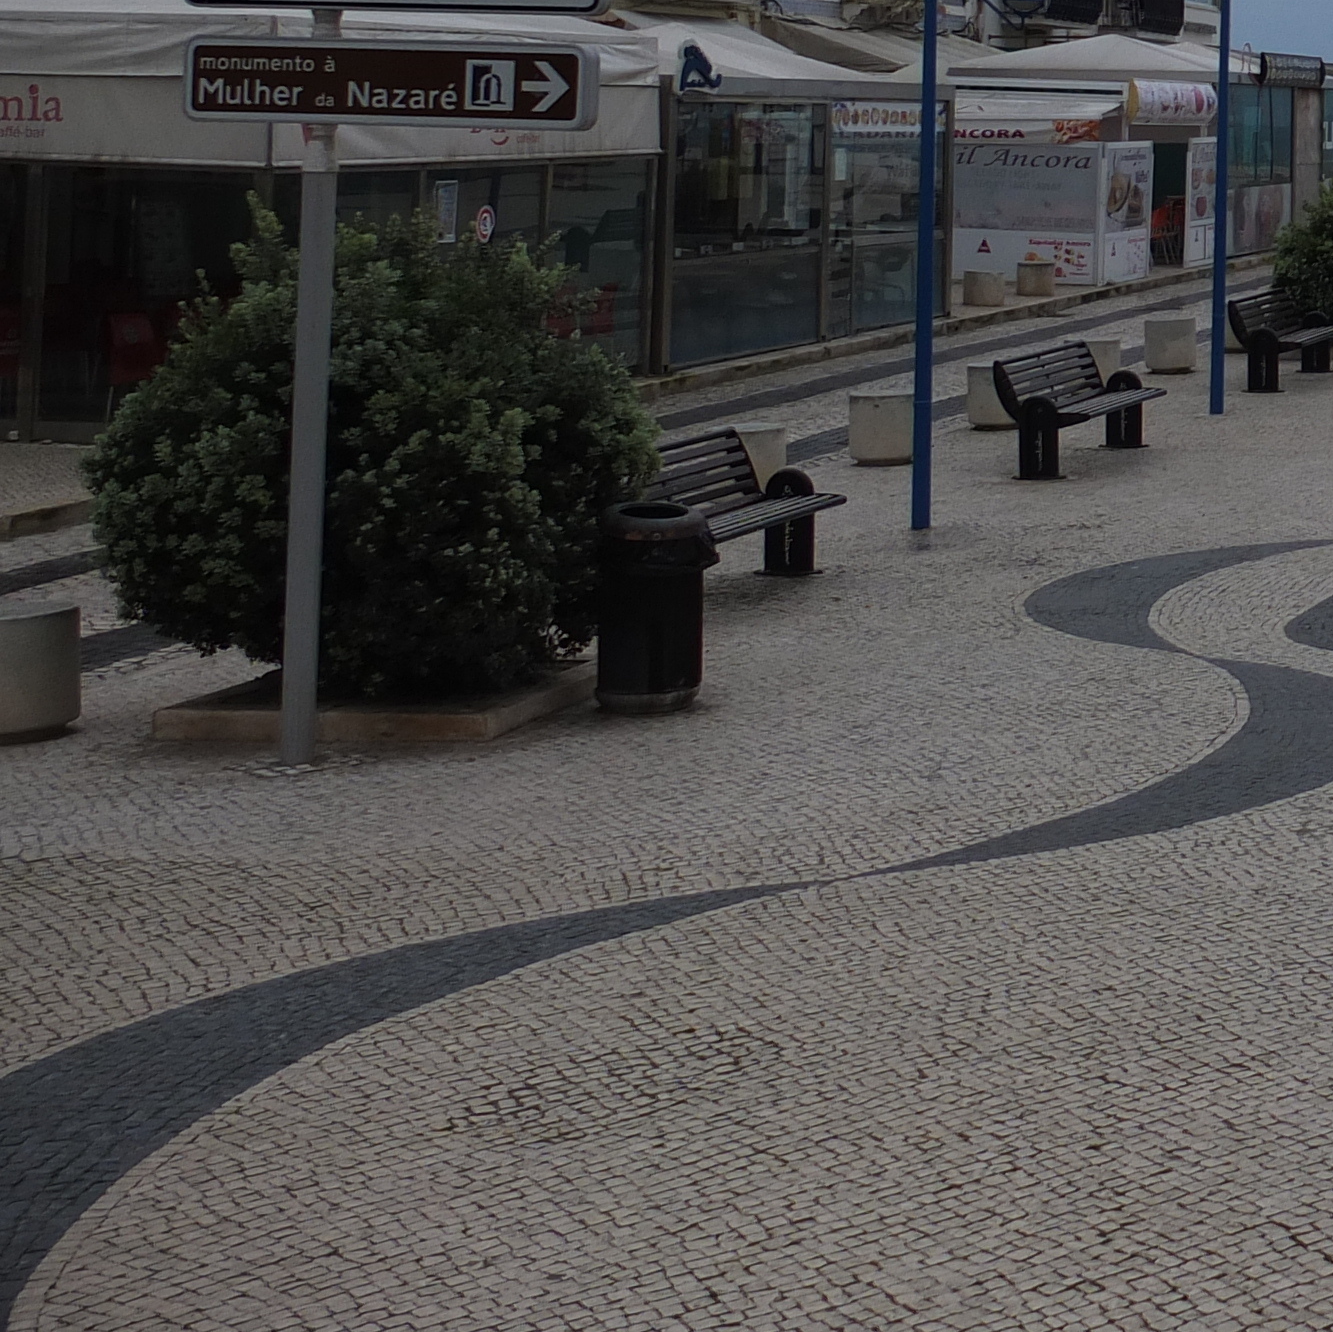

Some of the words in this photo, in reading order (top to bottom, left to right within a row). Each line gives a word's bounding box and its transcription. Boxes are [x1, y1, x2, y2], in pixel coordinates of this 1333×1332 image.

[200, 56, 315, 72] monumento
[324, 55, 336, 72] à
[198, 77, 303, 106] Mulher
[314, 92, 335, 108] da
[346, 80, 458, 110] Nazaré
[953, 129, 1025, 139] NCORA
[956, 145, 985, 165] il
[983, 148, 1093, 169] Ancora
